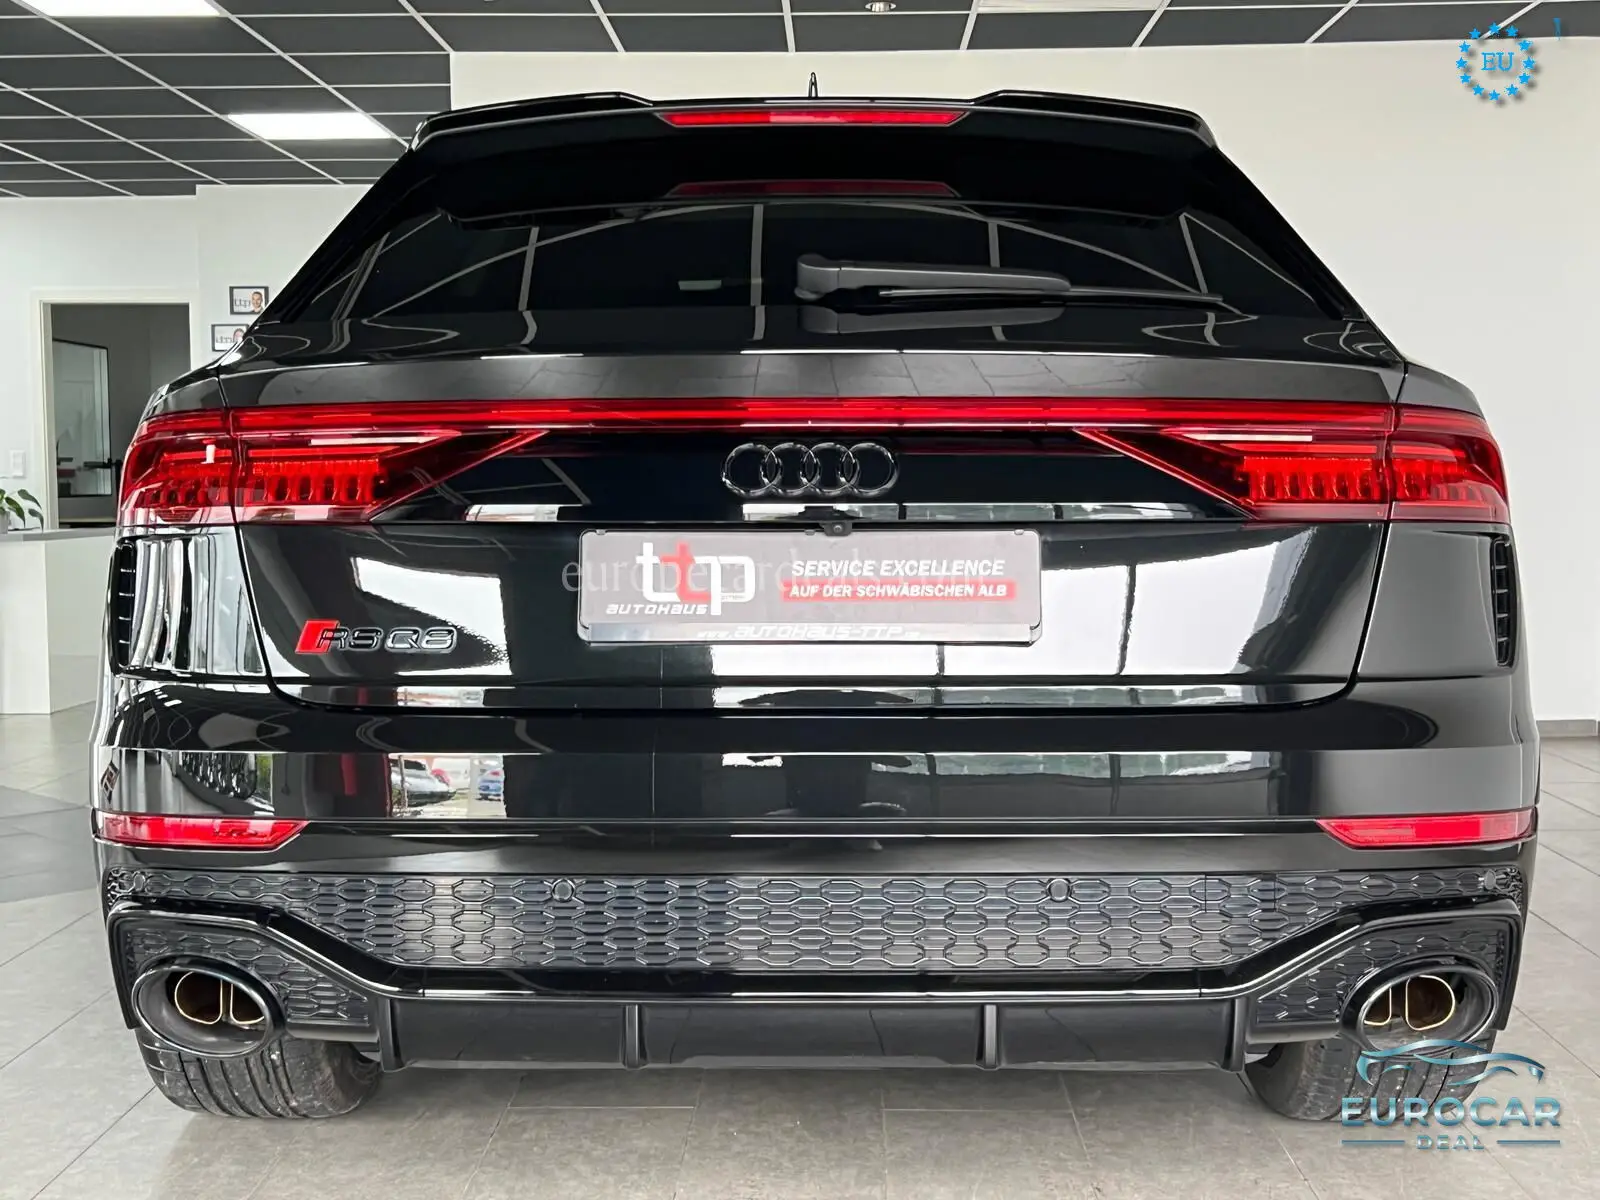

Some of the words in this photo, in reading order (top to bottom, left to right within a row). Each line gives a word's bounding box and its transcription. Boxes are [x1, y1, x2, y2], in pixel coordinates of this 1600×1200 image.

[635, 542, 756, 616] ttp
[791, 559, 876, 577] SERVICE
[879, 559, 1006, 577] EXCELLENCE
[789, 584, 819, 597] AUF
[823, 584, 852, 598] DER
[855, 583, 975, 598] SCHWÄBISCHEN
[977, 584, 1008, 597] ALB
[314, 626, 383, 651] RS
[384, 626, 458, 653] Q8
